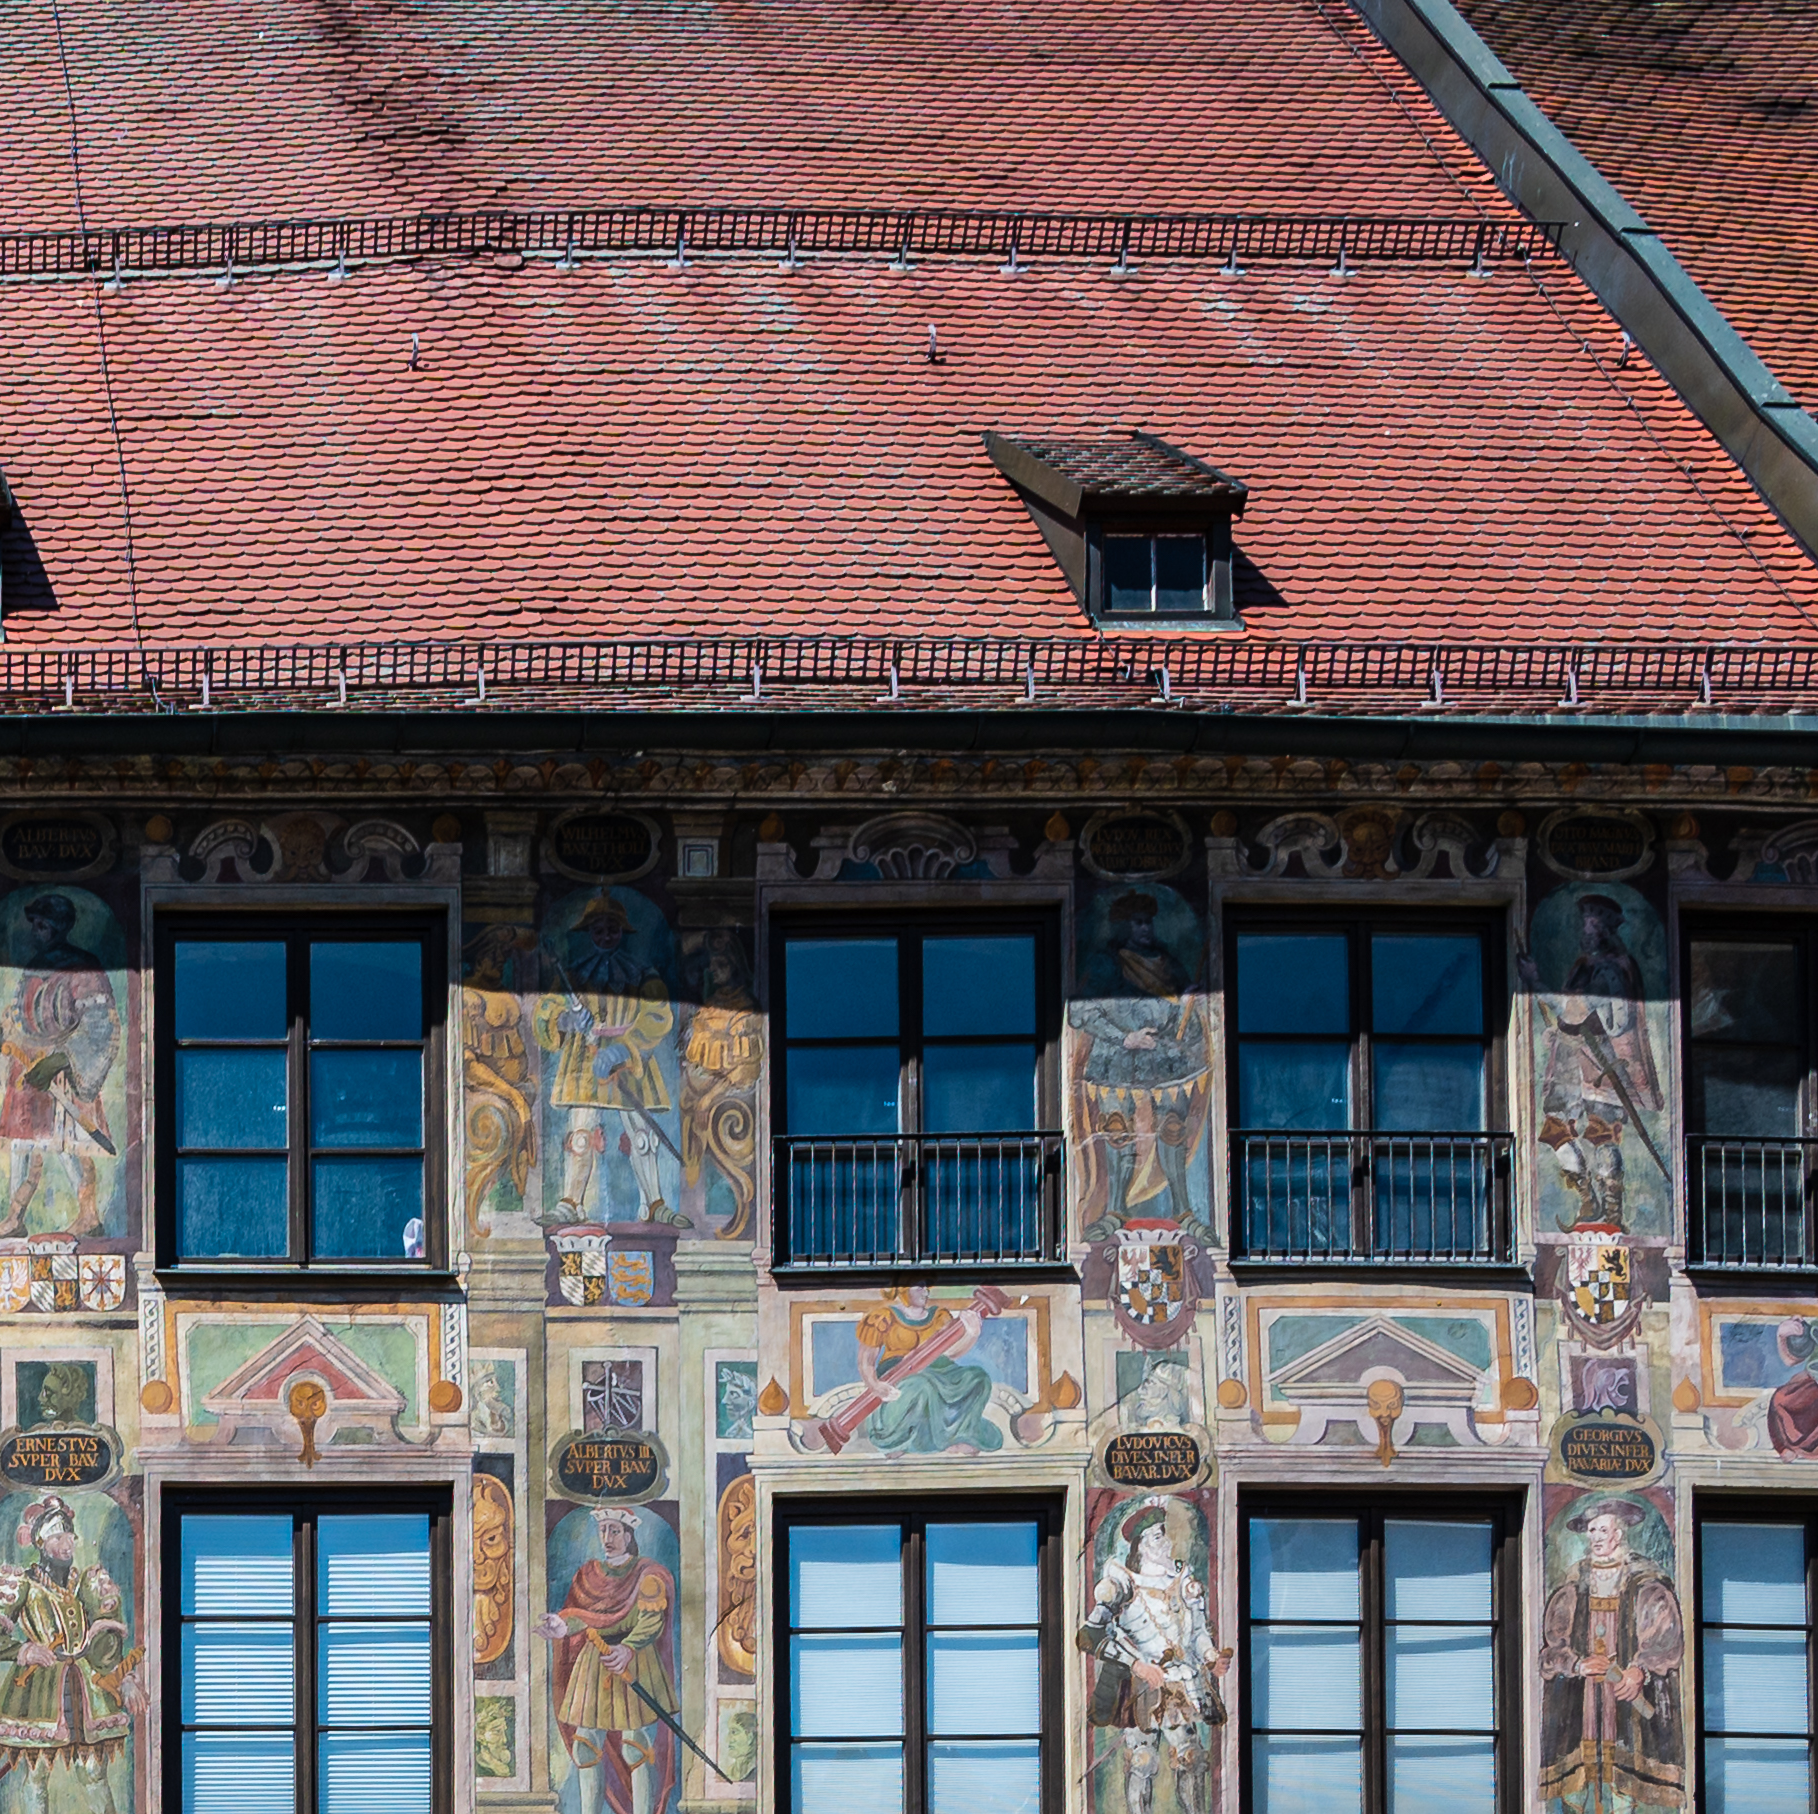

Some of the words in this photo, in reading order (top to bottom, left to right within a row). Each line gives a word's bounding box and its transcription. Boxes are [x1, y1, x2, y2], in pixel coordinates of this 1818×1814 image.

[59, 844, 93, 859] DVX
[16, 1438, 98, 1453] ERNESTVS
[1117, 1436, 1193, 1450] LVDOVICVS
[567, 1443, 636, 1459] ALBERTVS
[8, 1454, 57, 1468] SVPER
[565, 1461, 610, 1474] SVPER
[1625, 1459, 1650, 1472] DVX
[45, 1468, 81, 1481] DVX
[1162, 1466, 1194, 1479] DVX
[593, 1475, 627, 1489] DVX
